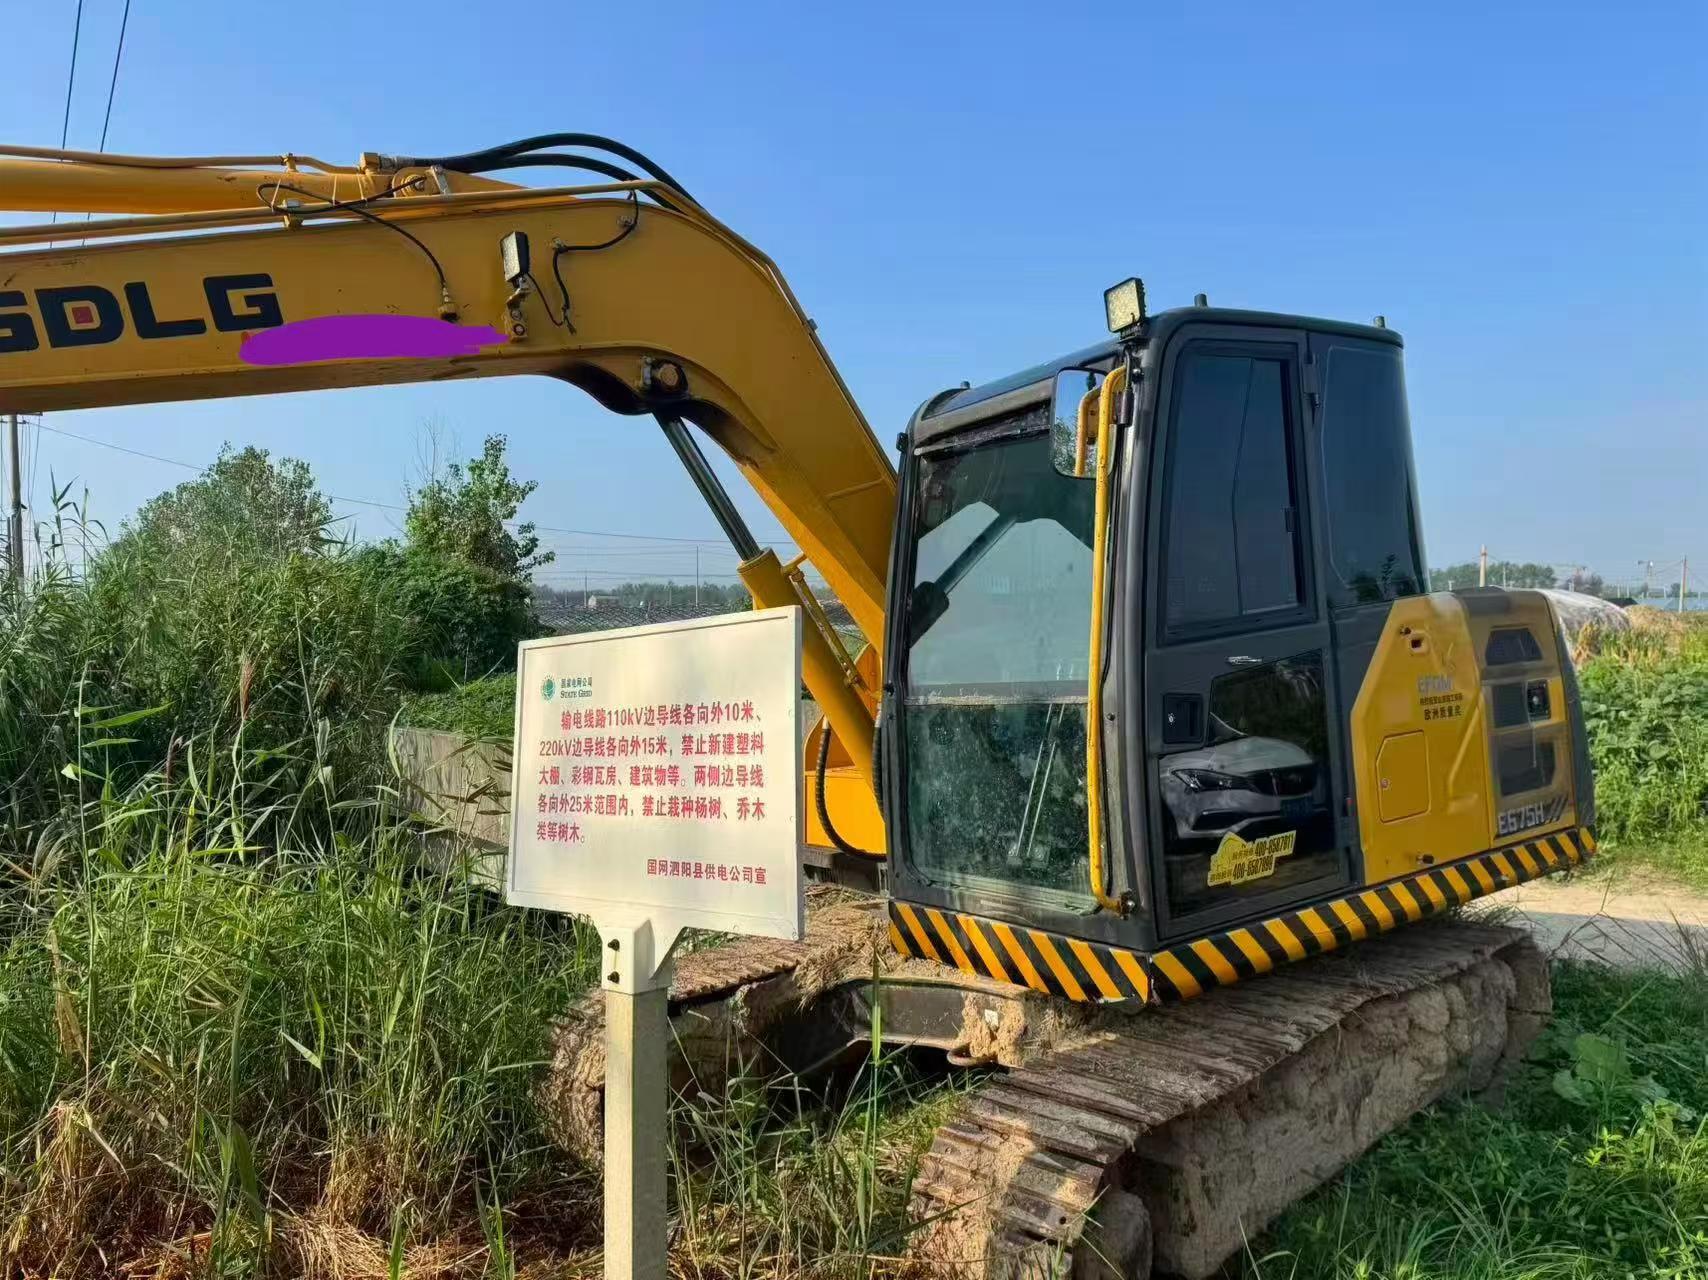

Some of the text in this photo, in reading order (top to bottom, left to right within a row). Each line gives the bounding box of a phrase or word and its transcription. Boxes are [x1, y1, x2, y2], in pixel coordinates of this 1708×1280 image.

[561, 700, 762, 731] 输电线路110kV边导线各向外10米、
[536, 820, 586, 844] 类等树木。
[647, 858, 767, 886] 国网泗阳县供电公司宣
